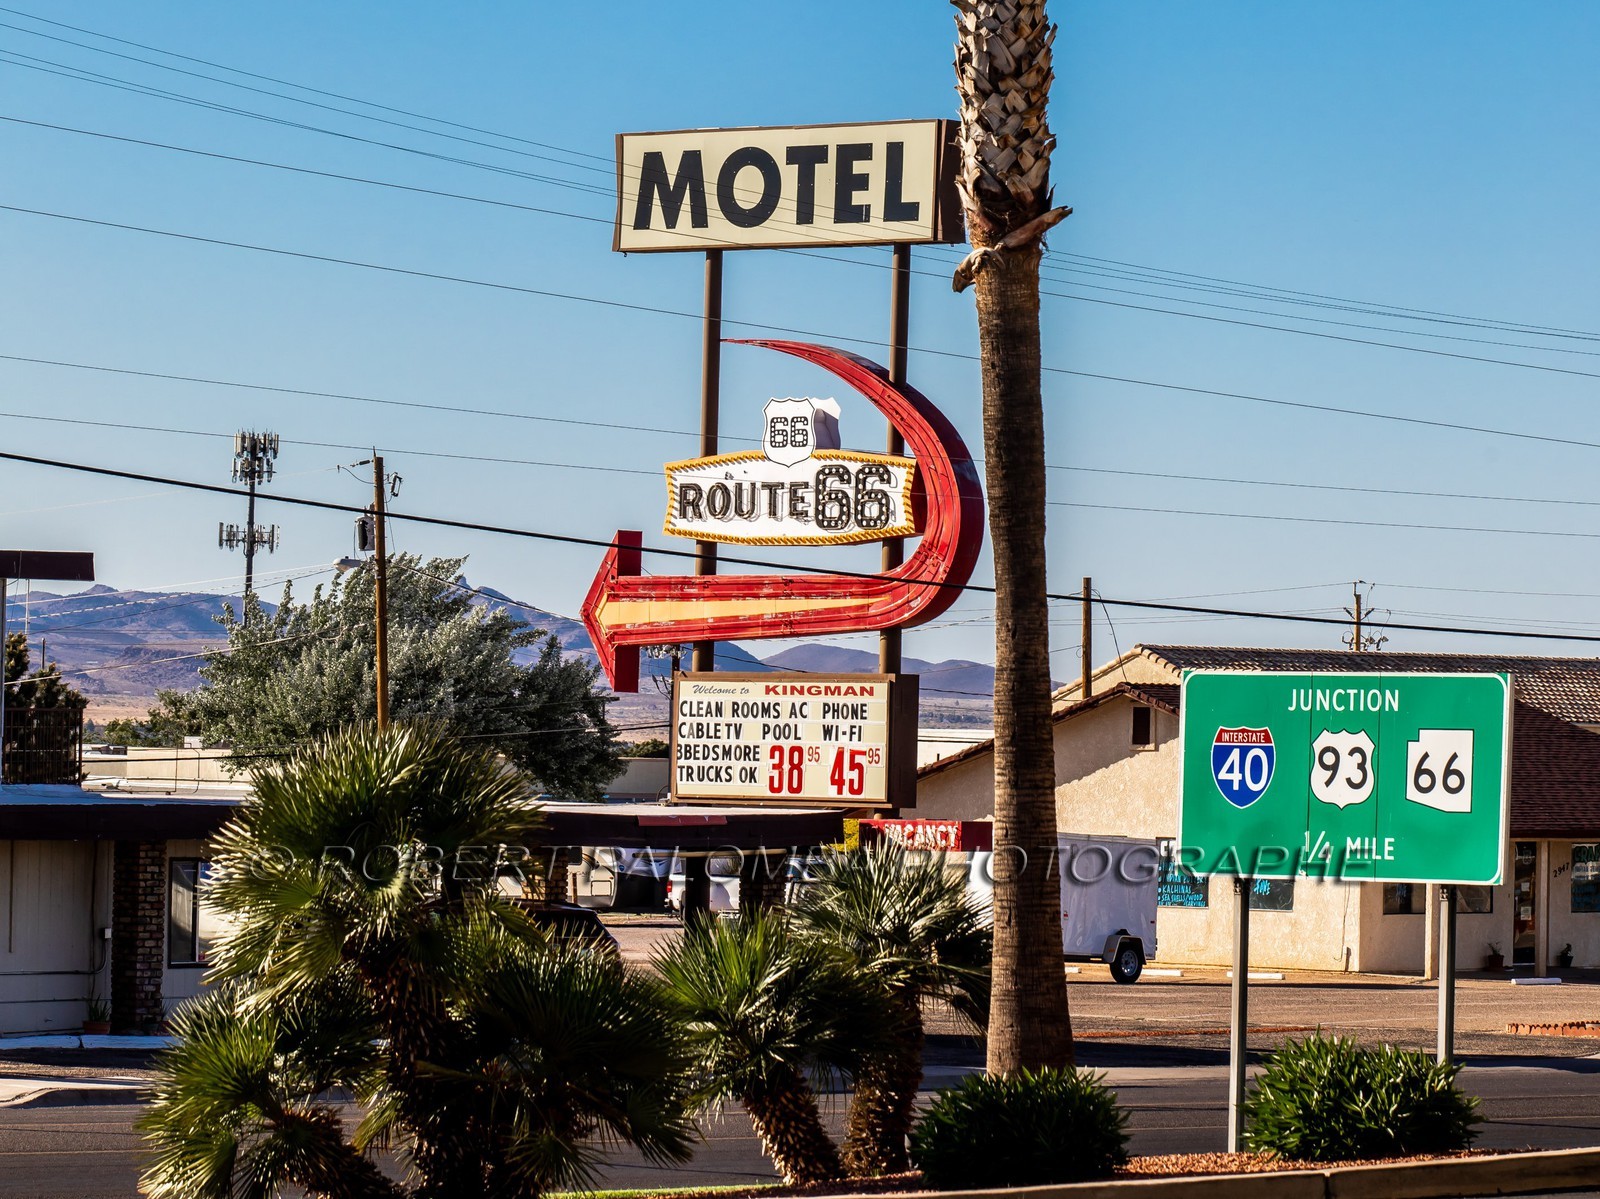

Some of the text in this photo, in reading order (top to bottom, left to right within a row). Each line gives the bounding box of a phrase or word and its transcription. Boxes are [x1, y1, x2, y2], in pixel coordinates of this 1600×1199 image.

[633, 141, 920, 230] MOTEL
[769, 416, 808, 448] 66
[679, 464, 891, 531] ROUTE 66
[692, 684, 875, 697] Welcome to KINGMAN
[1287, 688, 1399, 712] JUNCTION
[680, 700, 868, 720] CLEAN ROOMS AC PHONE
[762, 722, 802, 741] POOL
[822, 724, 862, 742] WI-FI
[1221, 731, 1266, 743] INTERSTATE
[677, 765, 758, 784] TRUCKS OK
[1217, 747, 1269, 792] 40
[1317, 745, 1368, 790] 93
[1413, 751, 1466, 795] 66
[1346, 836, 1395, 860] MILE
